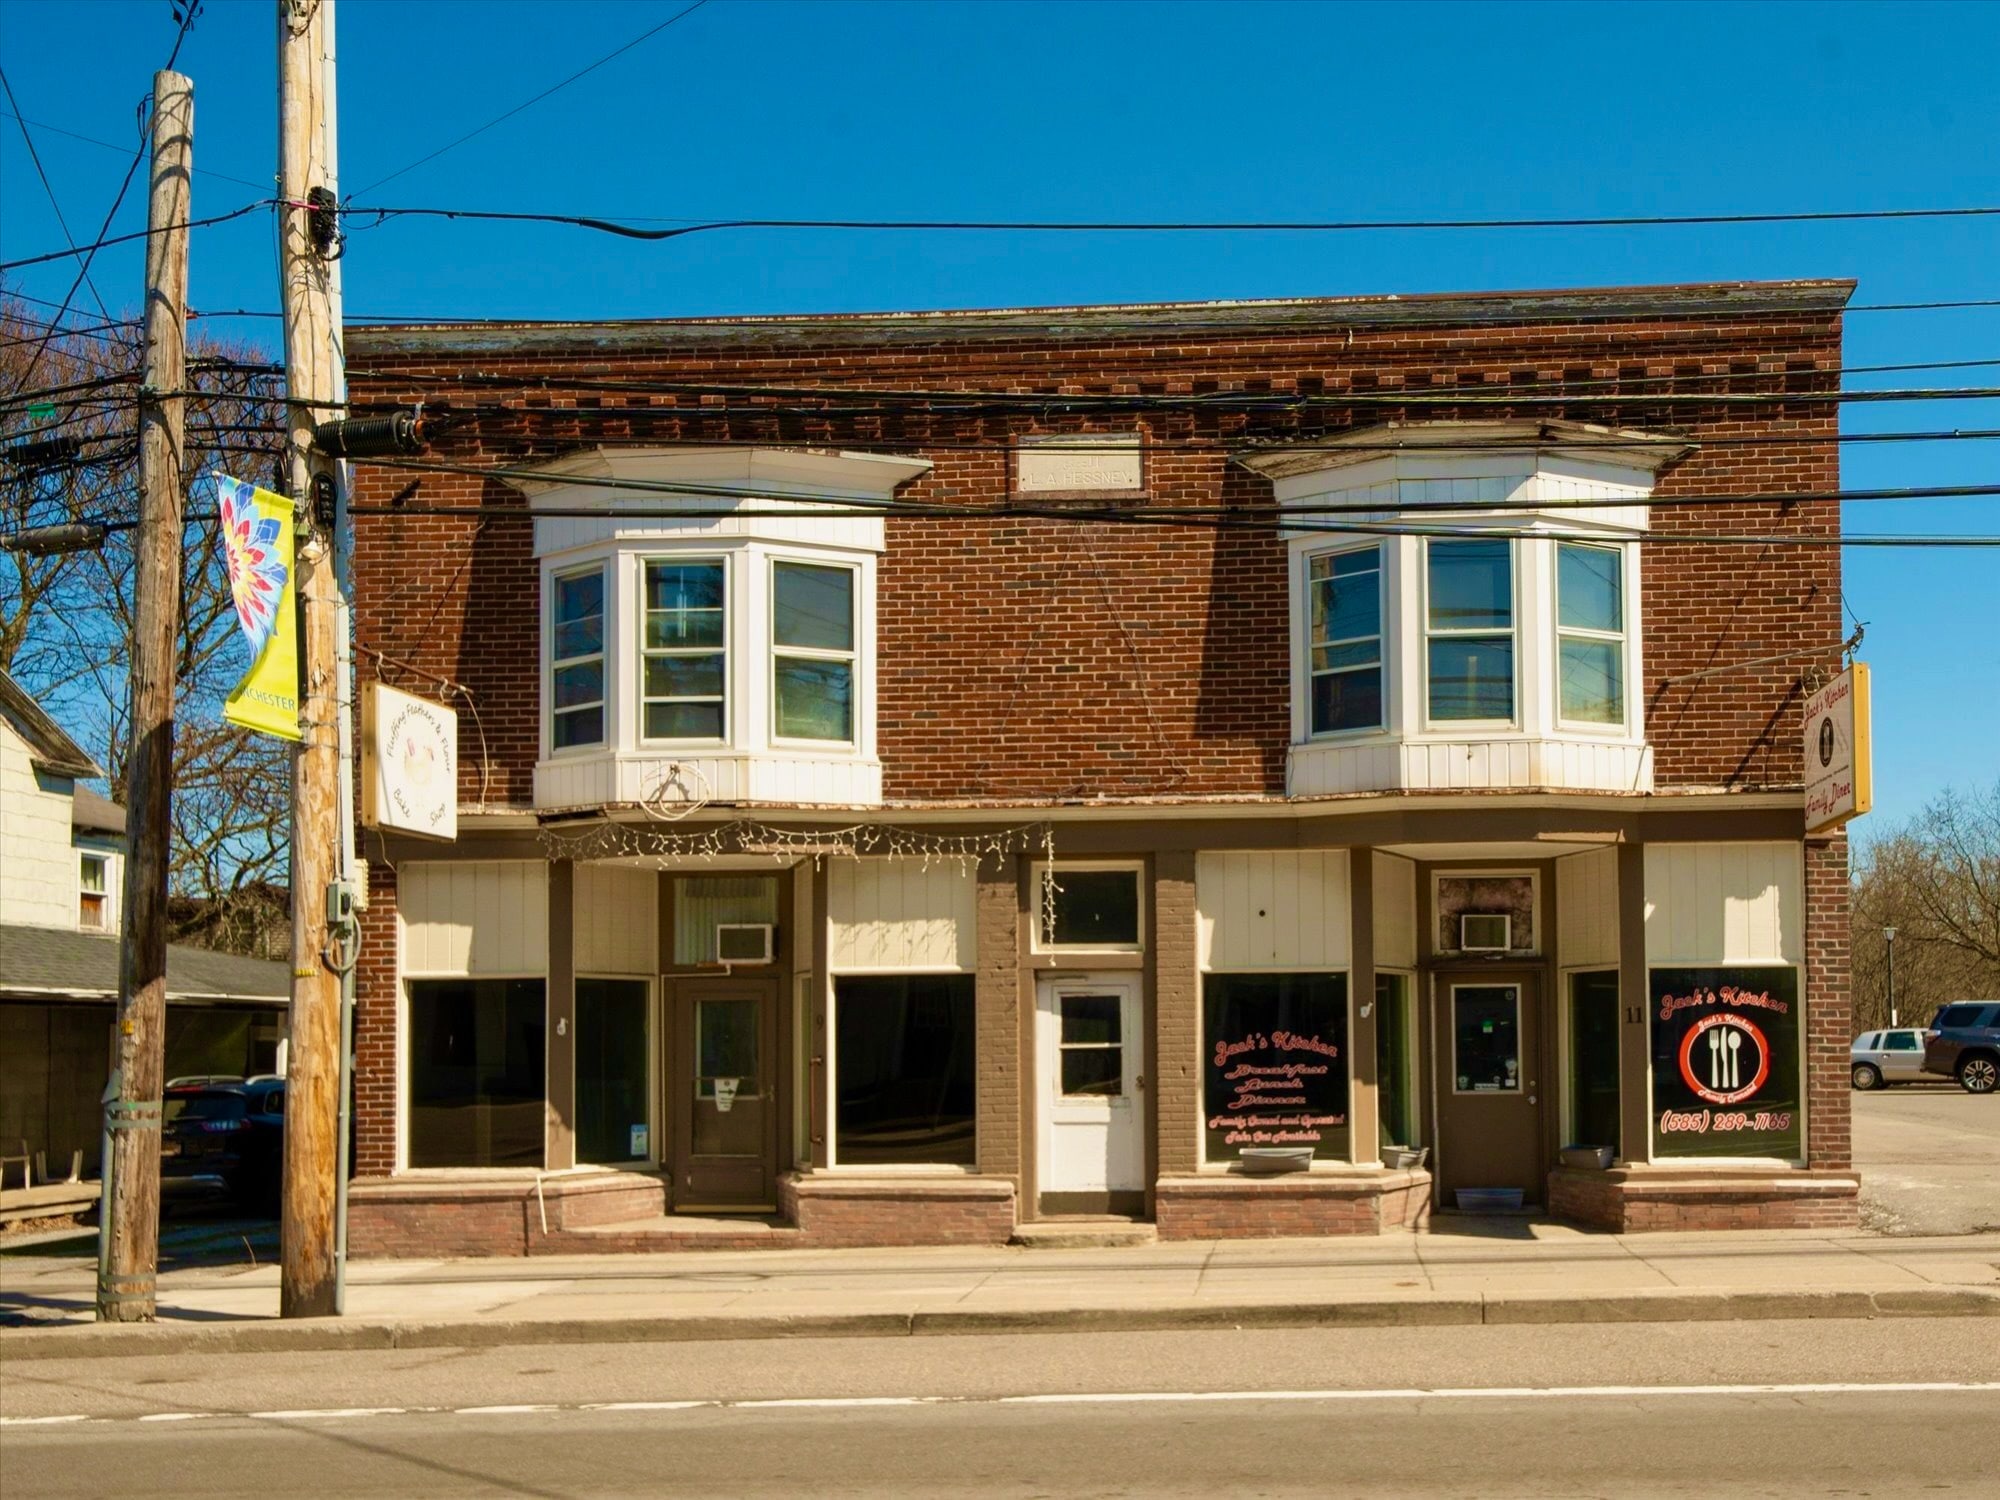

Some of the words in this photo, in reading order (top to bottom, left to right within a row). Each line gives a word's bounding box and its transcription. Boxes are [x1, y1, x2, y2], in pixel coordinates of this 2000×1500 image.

[1063, 471, 1130, 486] HESSNEY
[241, 687, 295, 711] NCHESTER
[1804, 695, 1823, 731] Jack's
[1824, 681, 1849, 709] Kitchen
[386, 712, 407, 757] Fluffing
[393, 788, 411, 818] Bake
[430, 803, 446, 826] Shop
[1805, 788, 1828, 820] Family
[1828, 782, 1851, 814] Diner
[1660, 987, 1716, 1020] Jack's
[1719, 985, 1788, 1014] Kitchen
[1626, 1007, 1643, 1024] 11
[1697, 1014, 1723, 1032] Jack's
[1724, 1013, 1754, 1032] Kitchen
[1214, 1032, 1268, 1066] Jack's
[1271, 1030, 1338, 1057] Kitchen
[1224, 1063, 1328, 1080] Breakfast
[1234, 1077, 1304, 1093] Lunch
[1227, 1093, 1307, 1110] Dinner
[1697, 1088, 1726, 1104] Family
[1209, 1114, 1247, 1129] Family
[1247, 1114, 1280, 1127] Owned
[1280, 1114, 1300, 1126] and
[1300, 1113, 1344, 1128] Operated
[1661, 1109, 1710, 1134] (585)
[1713, 1113, 1790, 1131] 289-1165
[1225, 1130, 1252, 1145] Take
[1252, 1130, 1272, 1143] Out
[1271, 1129, 1321, 1144] Available
